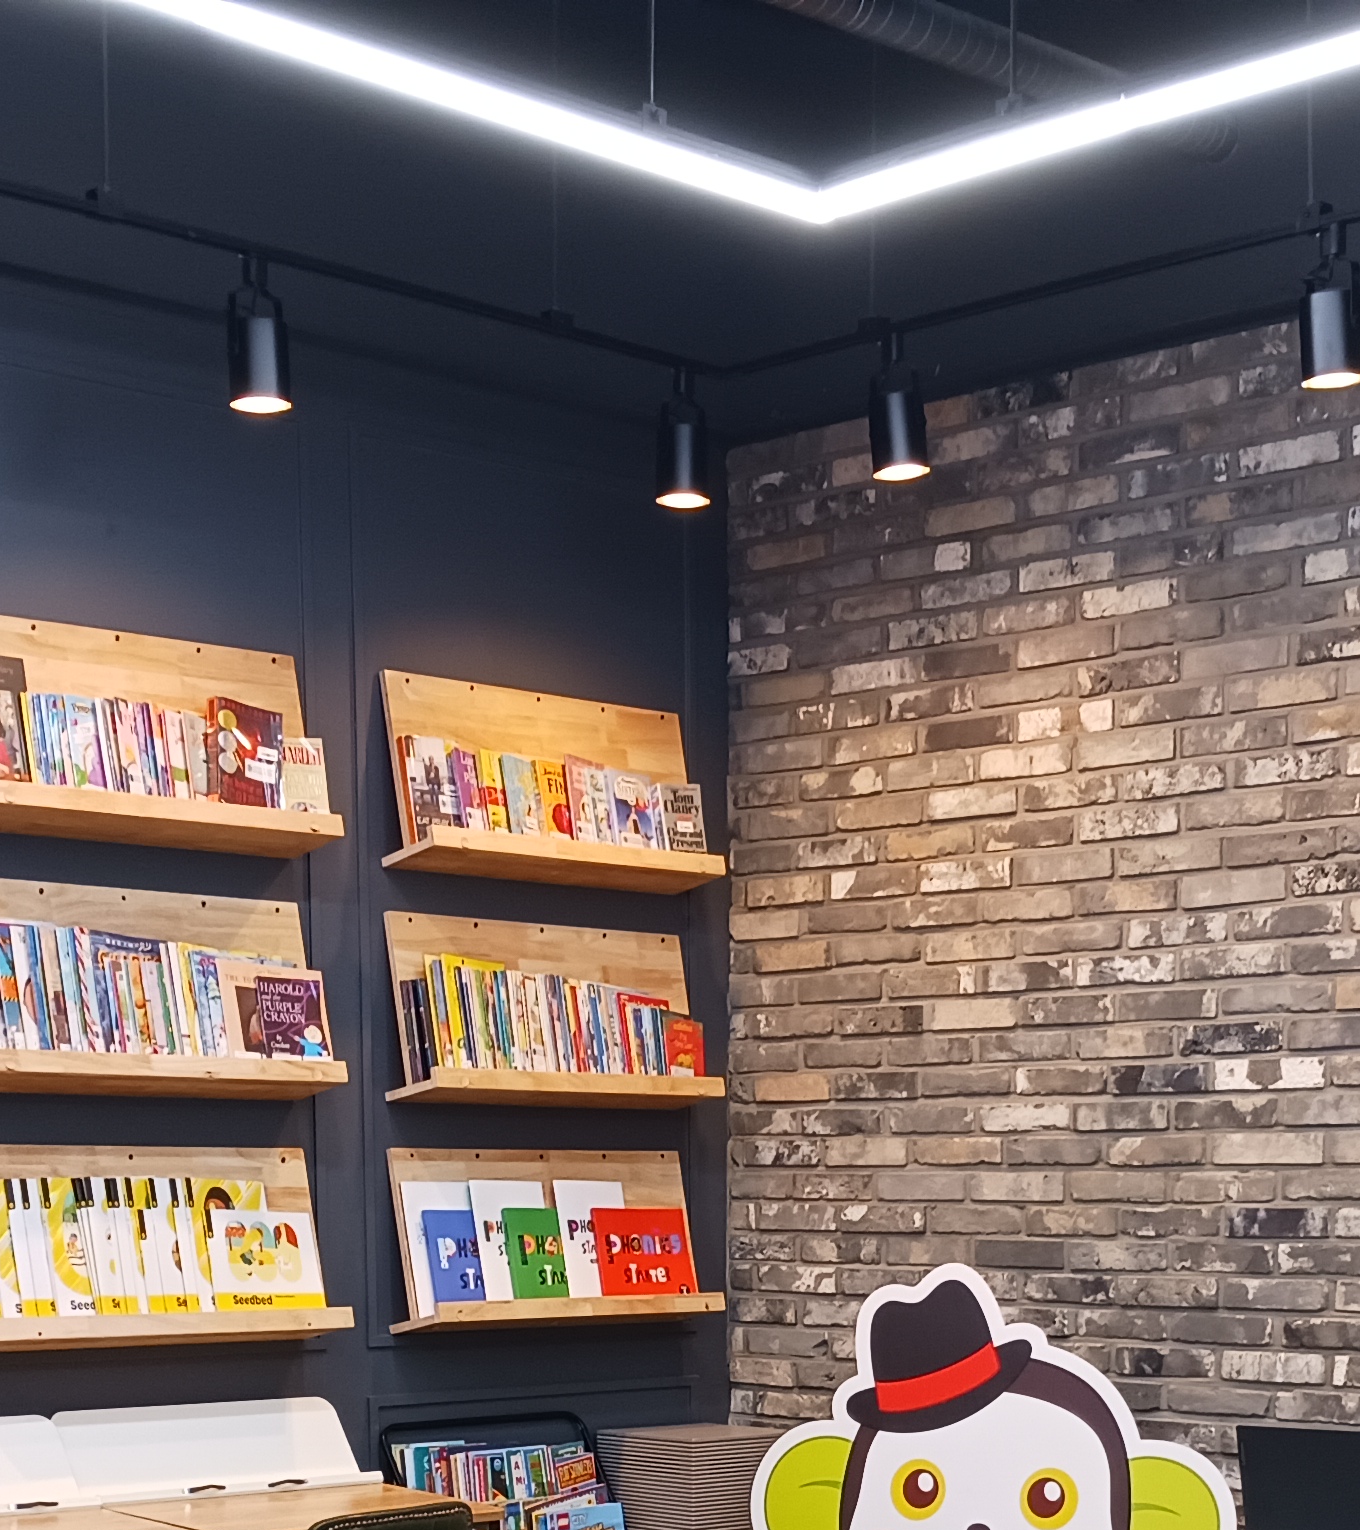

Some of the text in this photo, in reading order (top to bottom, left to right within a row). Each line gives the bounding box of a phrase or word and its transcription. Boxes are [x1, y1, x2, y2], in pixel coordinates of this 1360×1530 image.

[671, 790, 694, 805] Tom
[664, 800, 700, 816] Clancy
[260, 981, 304, 996] HAROLD
[262, 1000, 302, 1014] PURPLE
[263, 1011, 305, 1025] CRAYON
[232, 1295, 273, 1305] Seedbed
